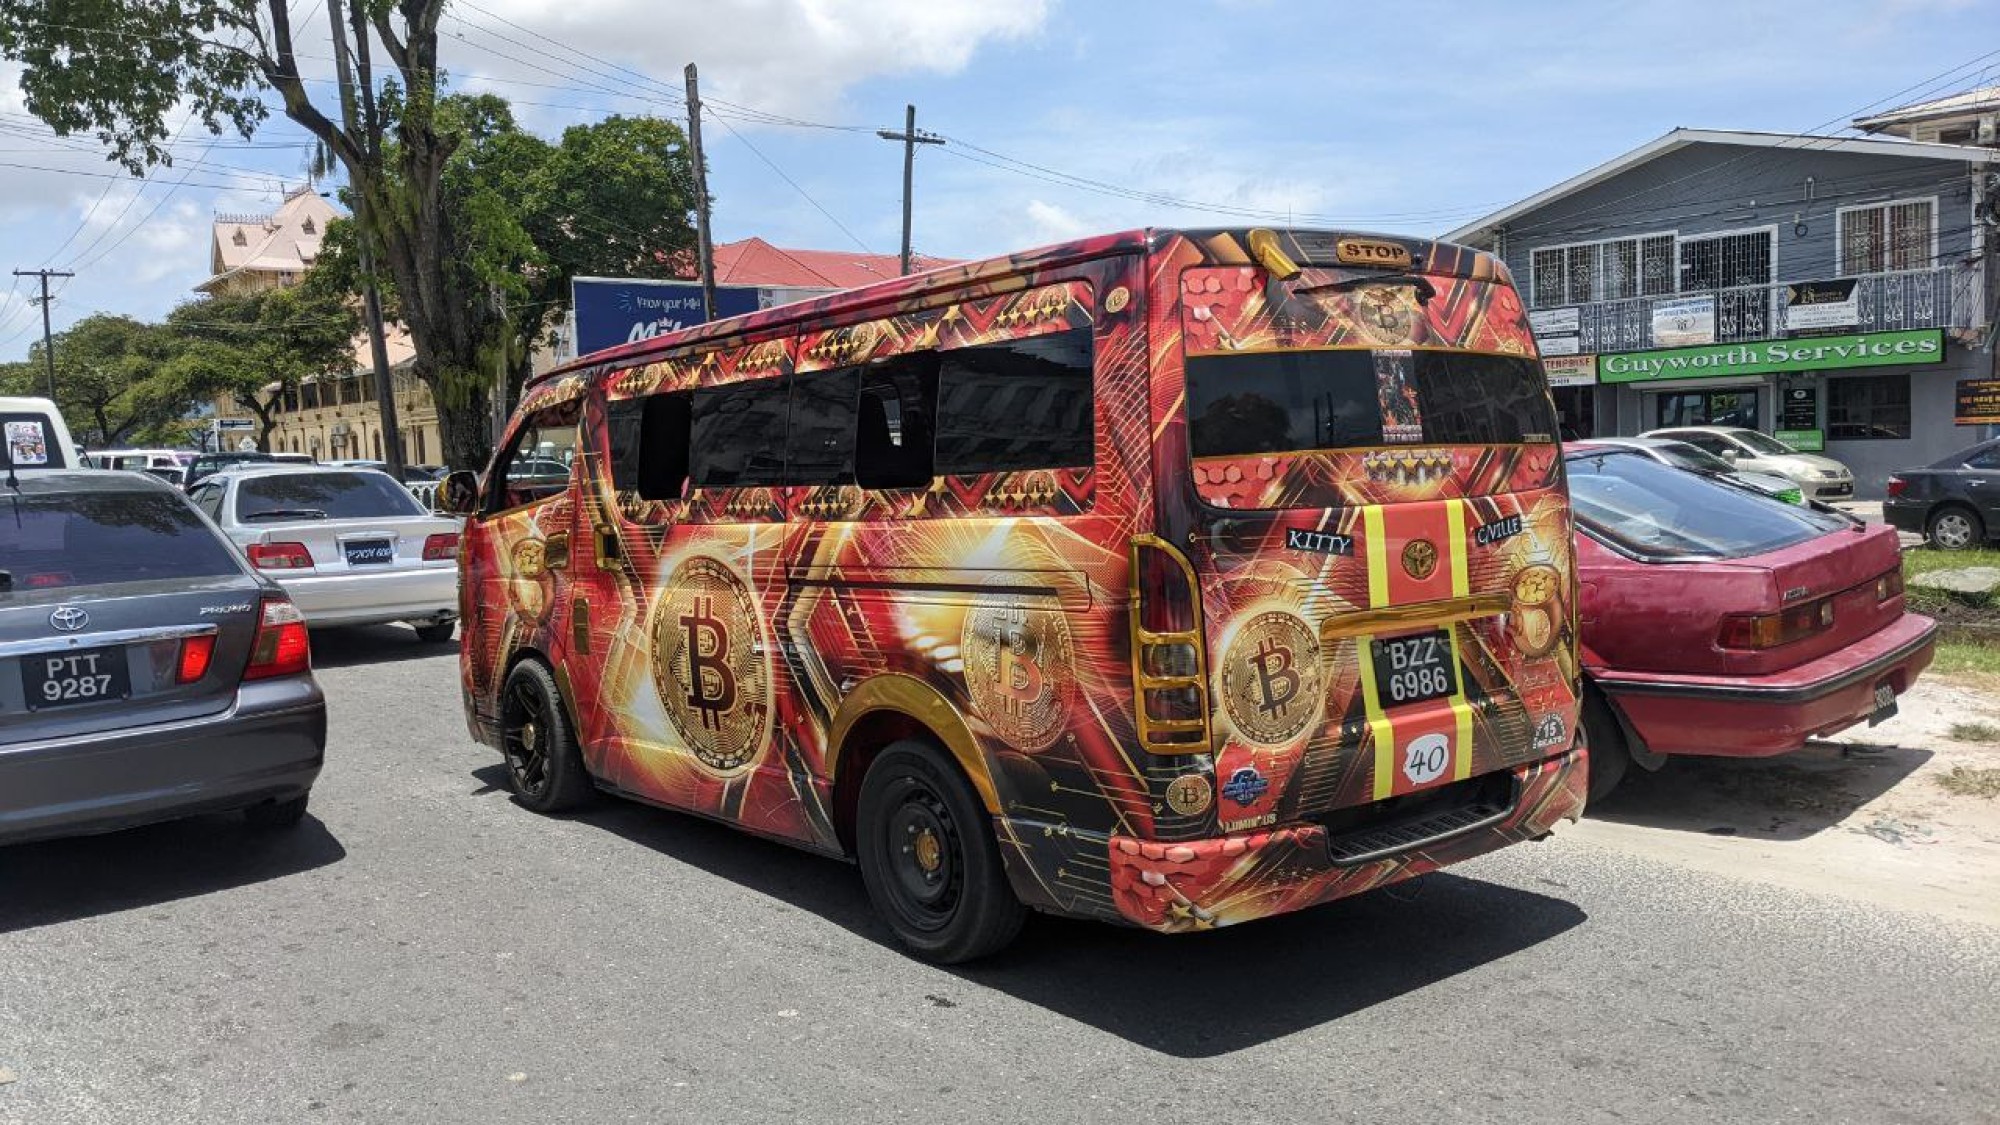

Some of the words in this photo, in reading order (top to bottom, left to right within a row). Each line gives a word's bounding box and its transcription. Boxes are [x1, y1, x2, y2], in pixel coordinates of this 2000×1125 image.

[1345, 243, 1404, 260] STOP
[1544, 357, 1590, 369] TERPRISE
[1605, 346, 1758, 375] Guyworth
[1767, 338, 1937, 363] Services
[1289, 530, 1351, 553] KITTY
[46, 654, 101, 679] PTT
[1390, 637, 1439, 670] BZZ
[43, 674, 112, 701] 9287
[1390, 666, 1448, 701] 6986
[1410, 745, 1445, 775] 40
[1225, 813, 1277, 834] LUMINUS
